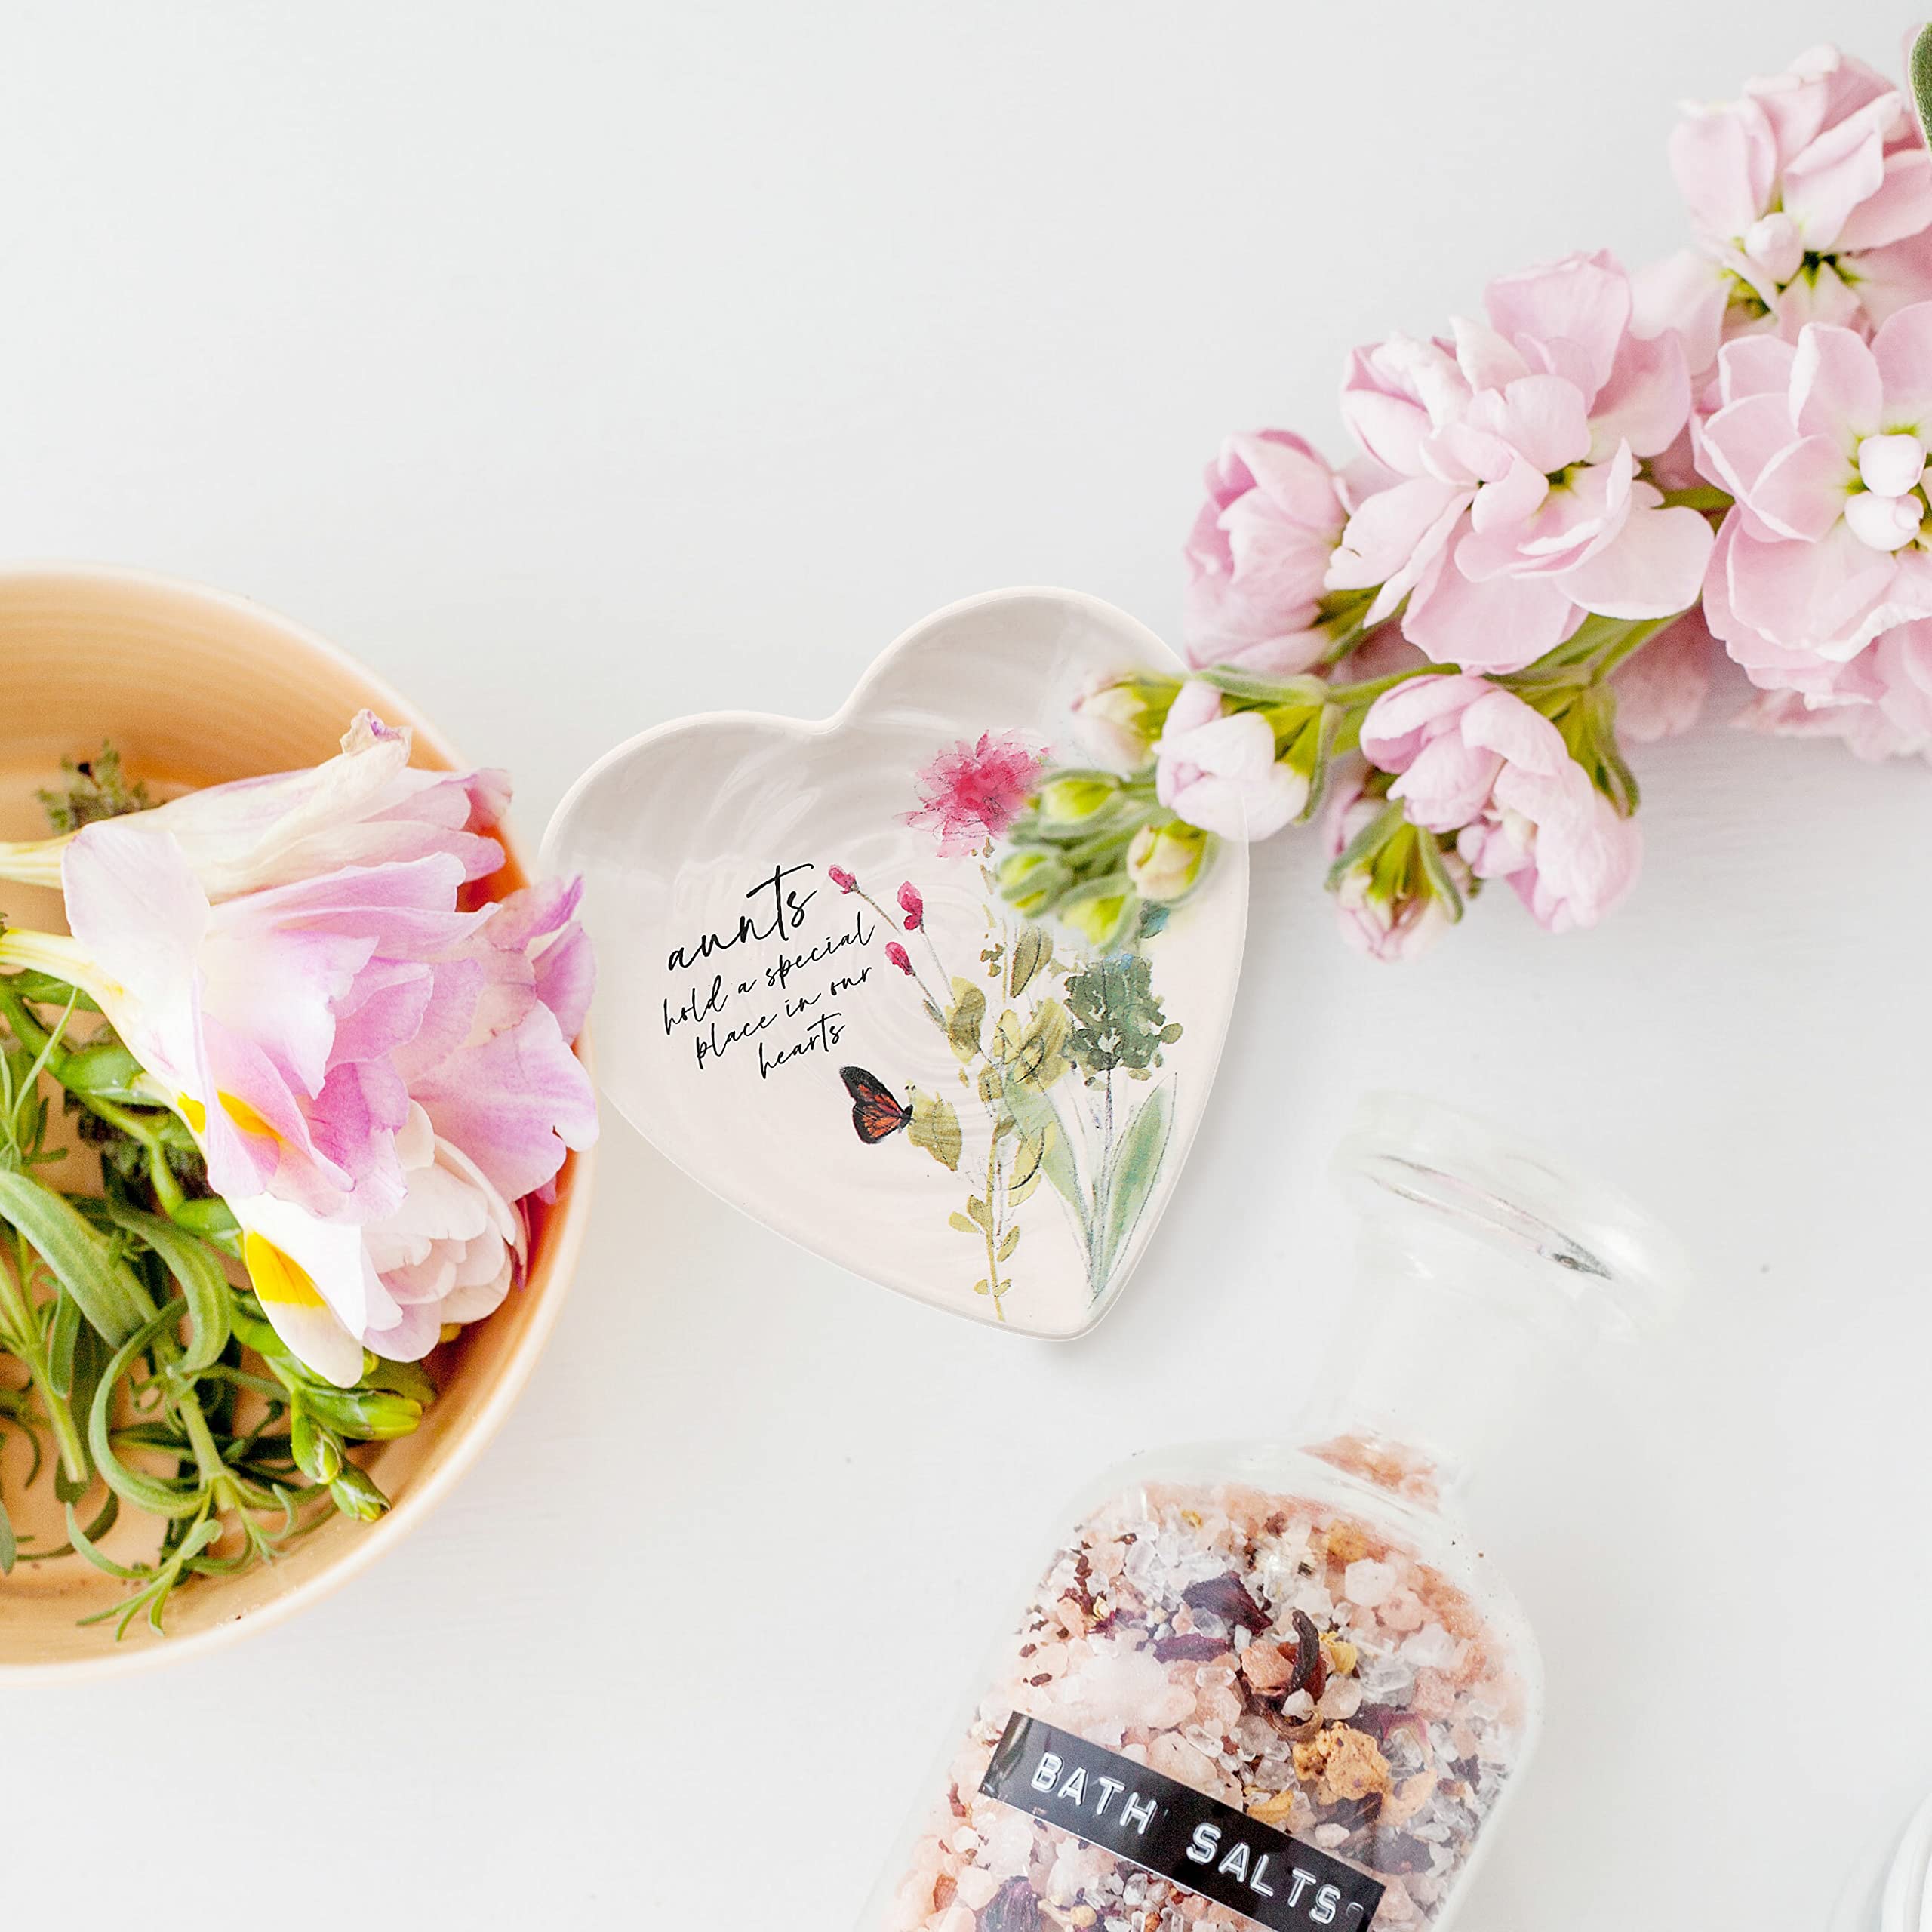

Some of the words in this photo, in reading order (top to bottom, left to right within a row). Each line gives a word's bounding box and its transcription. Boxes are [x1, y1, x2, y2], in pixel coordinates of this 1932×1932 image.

[668, 863, 817, 971] aunts
[663, 974, 728, 1035] hold
[737, 979, 758, 994] a
[765, 911, 875, 989] special
[696, 1014, 778, 1070] place
[785, 993, 822, 1017] in
[830, 967, 872, 996] our
[758, 1012, 846, 1079] hearts
[1031, 1752, 1158, 1835] BATH
[1186, 1823, 1341, 1924] SALTS
